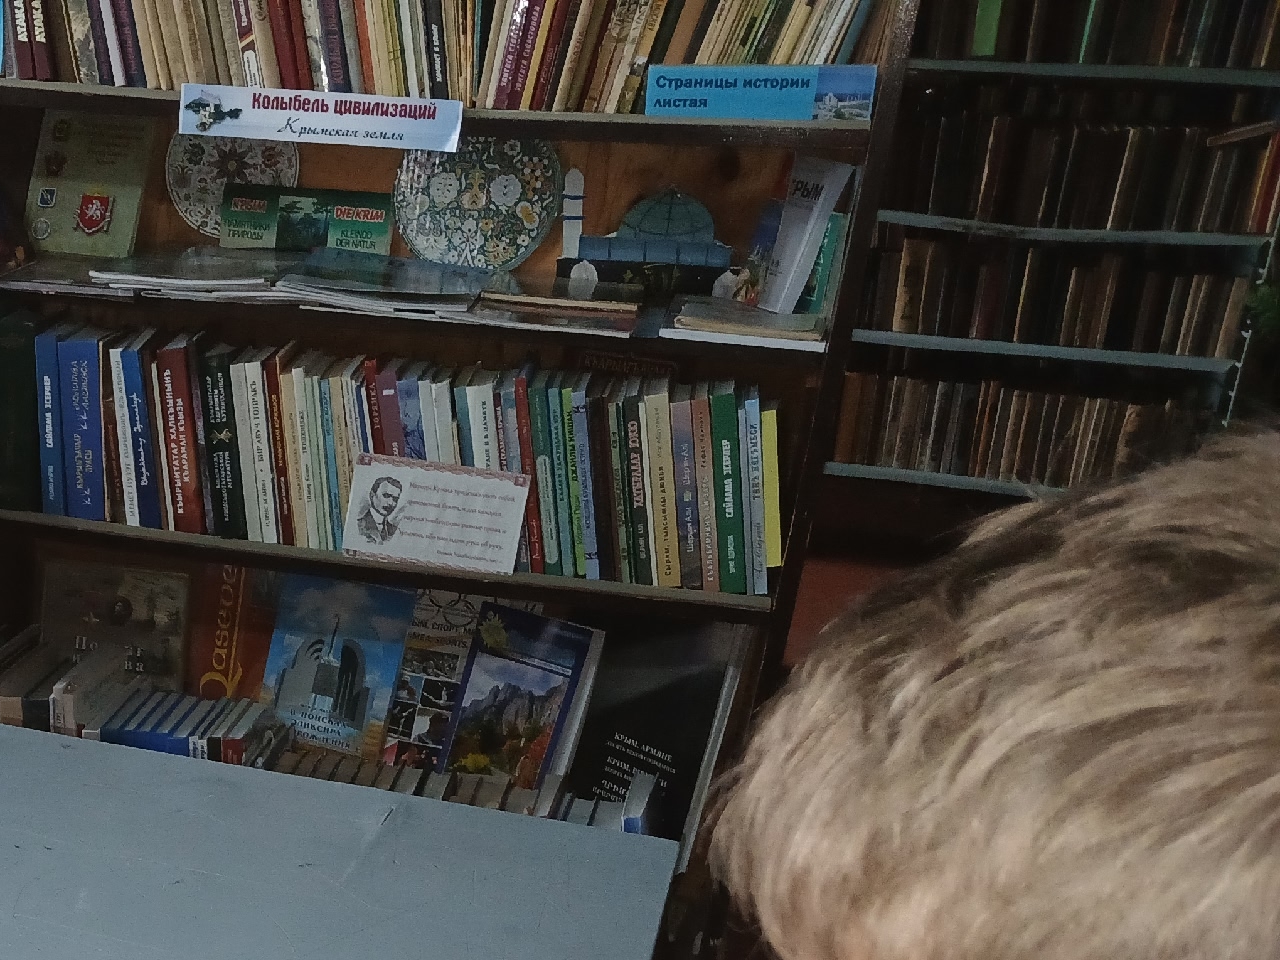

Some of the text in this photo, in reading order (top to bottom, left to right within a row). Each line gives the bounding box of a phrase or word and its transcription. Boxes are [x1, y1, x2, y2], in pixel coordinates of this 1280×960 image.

[654, 75, 811, 91] Страницы истории
[251, 92, 438, 121] Колыбель цивилизаций
[653, 96, 708, 109] листая
[276, 116, 405, 142] Крымская земля
[368, 382, 380, 429] ГОРЯНКА
